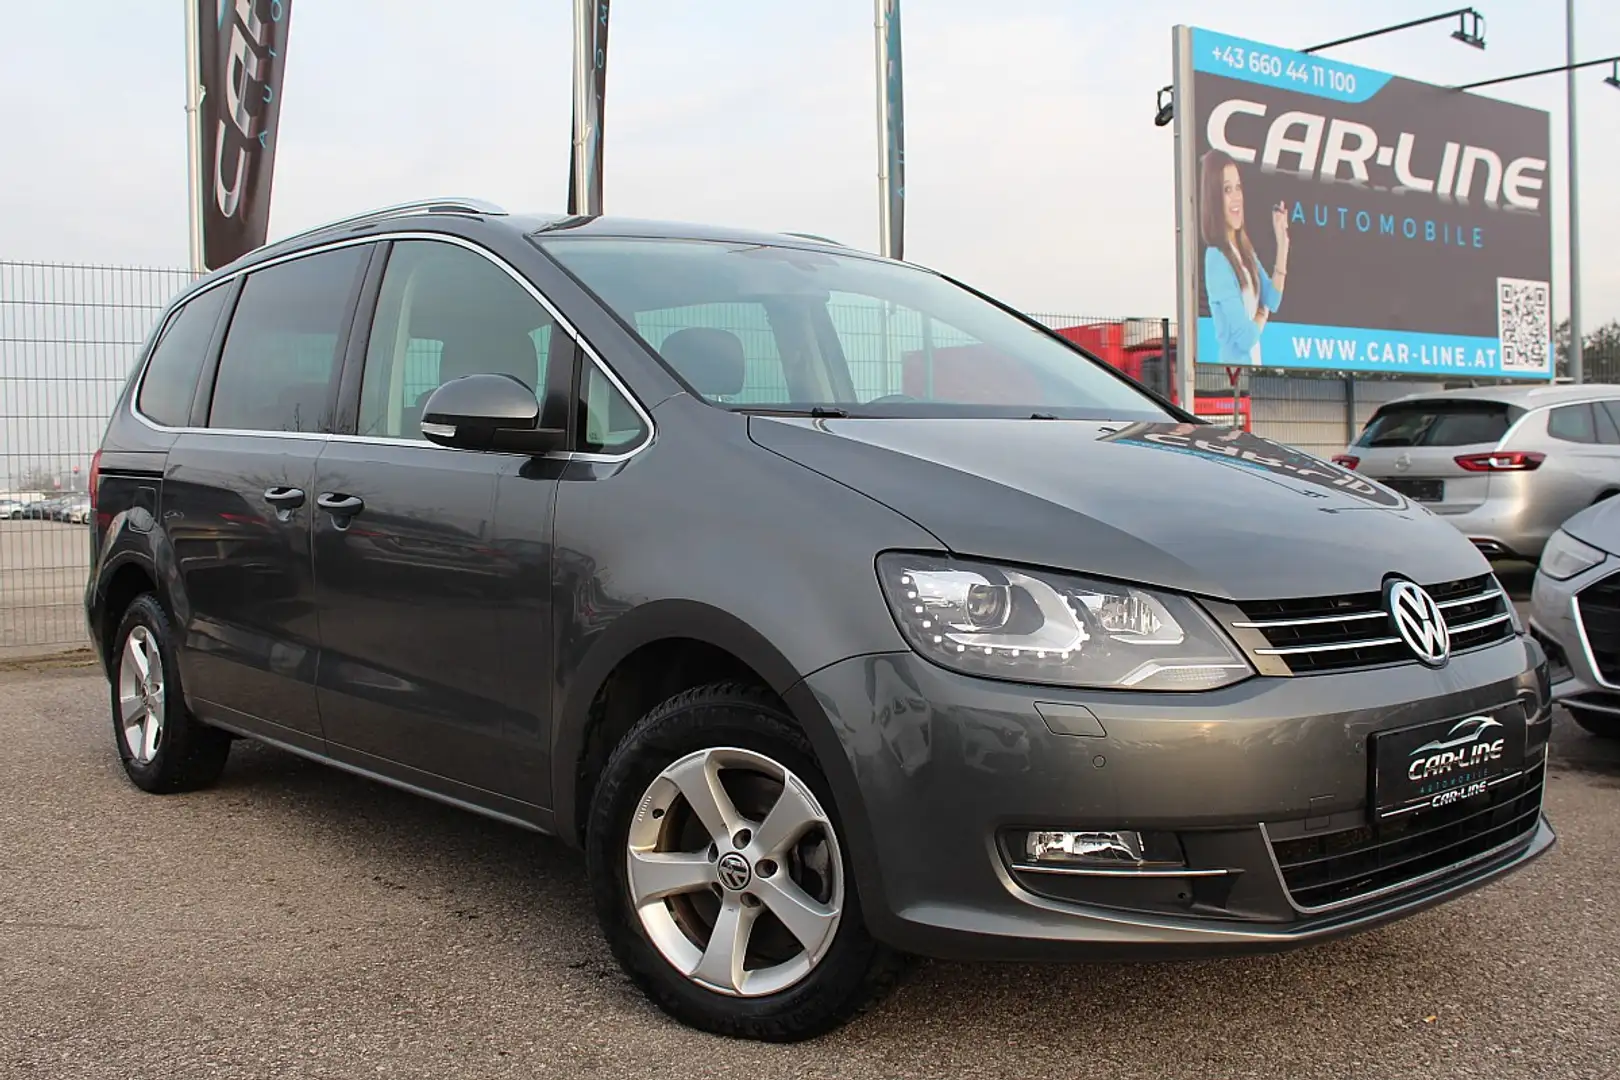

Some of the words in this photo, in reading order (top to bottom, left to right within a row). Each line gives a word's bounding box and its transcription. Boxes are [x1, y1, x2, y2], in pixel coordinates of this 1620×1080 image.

[1212, 45, 1245, 69] +43
[1249, 51, 1281, 78] 660
[1286, 61, 1309, 84] 44
[1312, 67, 1325, 88] 11
[1329, 71, 1356, 94] 100
[1206, 98, 1548, 210] CAR-LINE
[1292, 202, 1485, 249] AUTOMOBILE
[1292, 336, 1497, 369] WWW.CAR-LINE.AT
[1408, 738, 1504, 780] CAR-LINE
[1432, 781, 1487, 807] CAR-LINE
